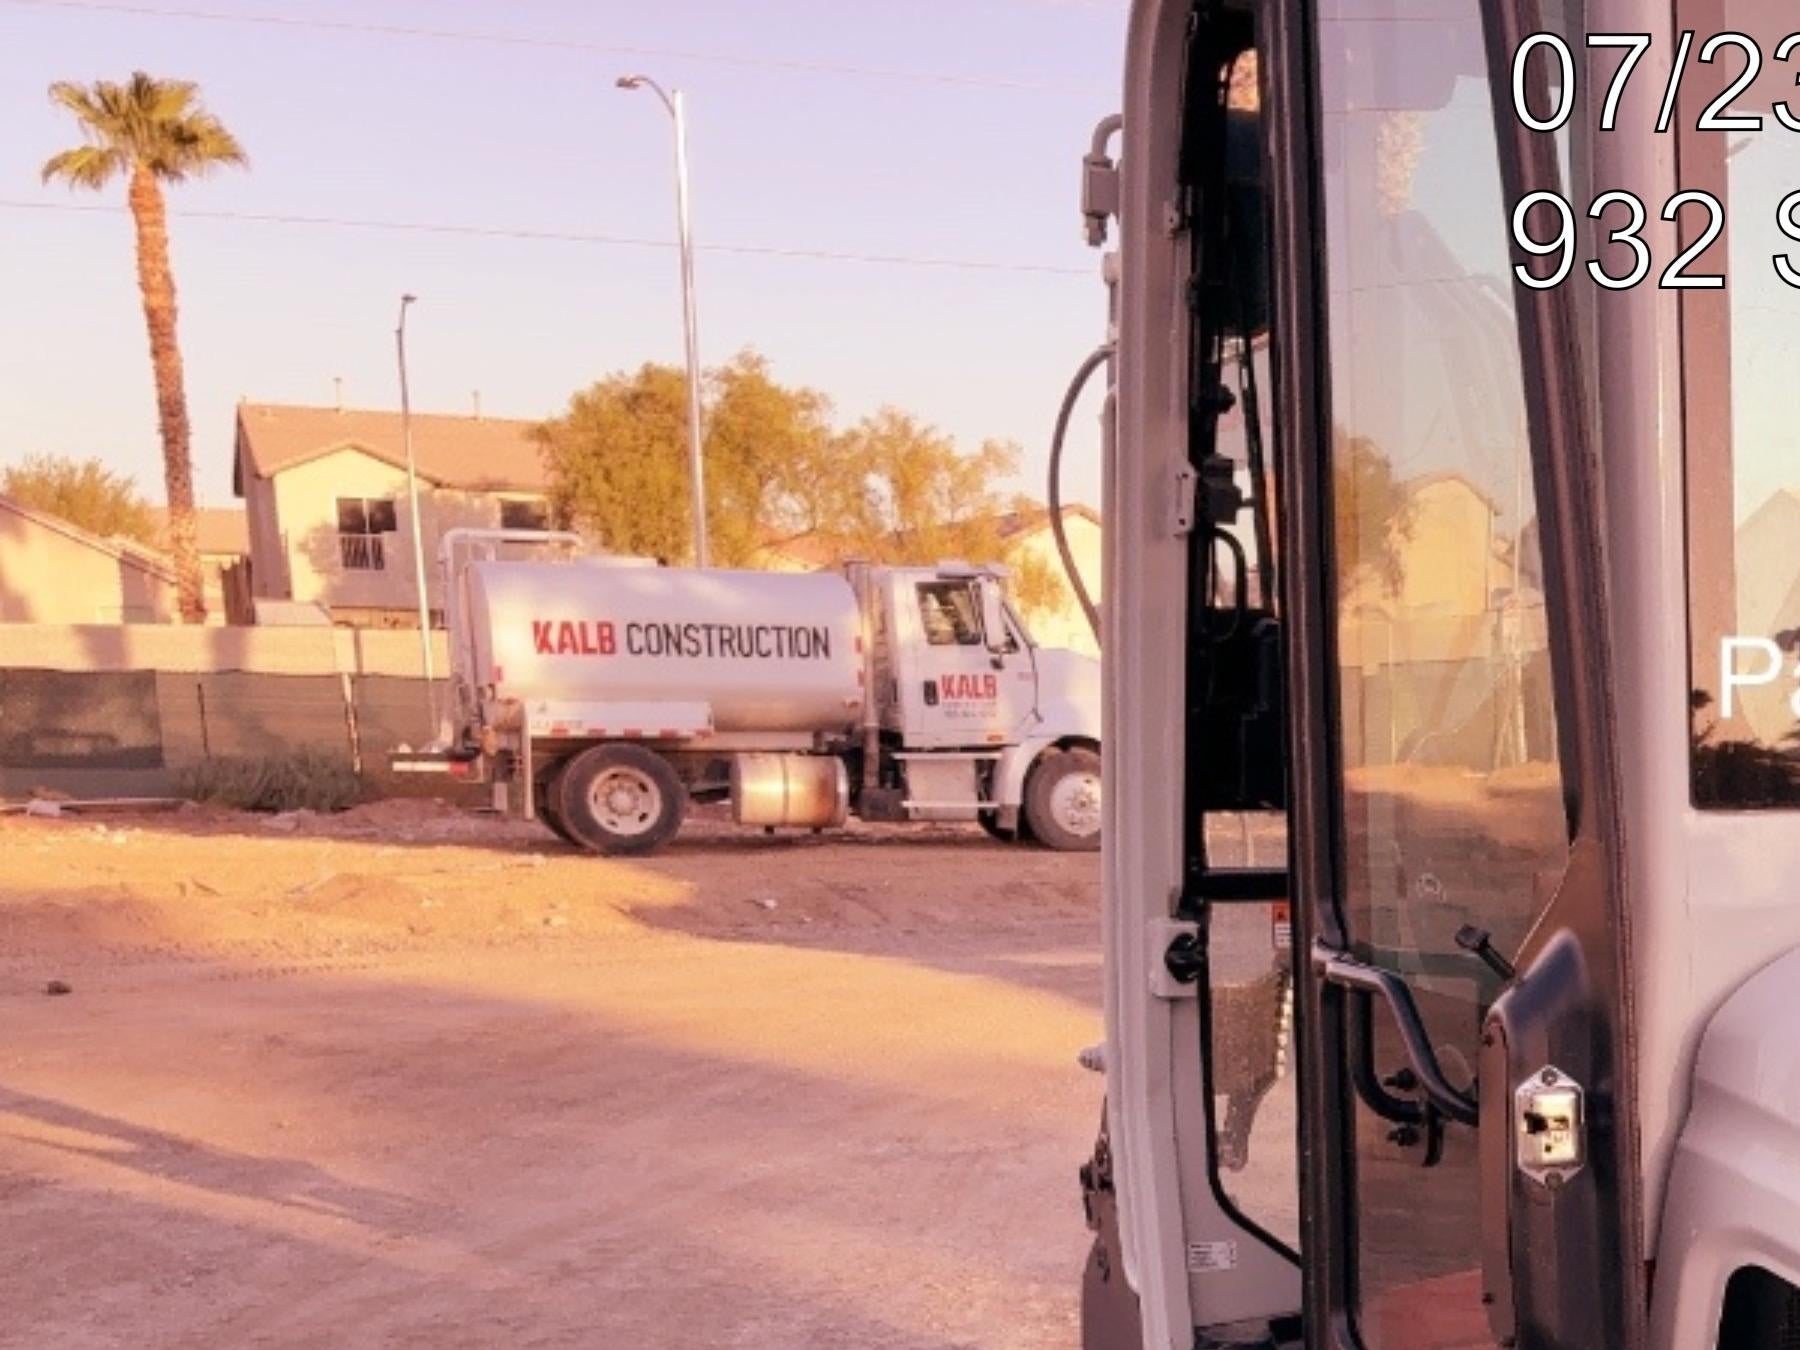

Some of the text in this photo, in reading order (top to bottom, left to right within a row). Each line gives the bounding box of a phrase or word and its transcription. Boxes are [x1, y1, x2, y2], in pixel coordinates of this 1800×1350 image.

[532, 620, 832, 659] KALB CONSTRUCTION
[941, 673, 997, 699] KALB
